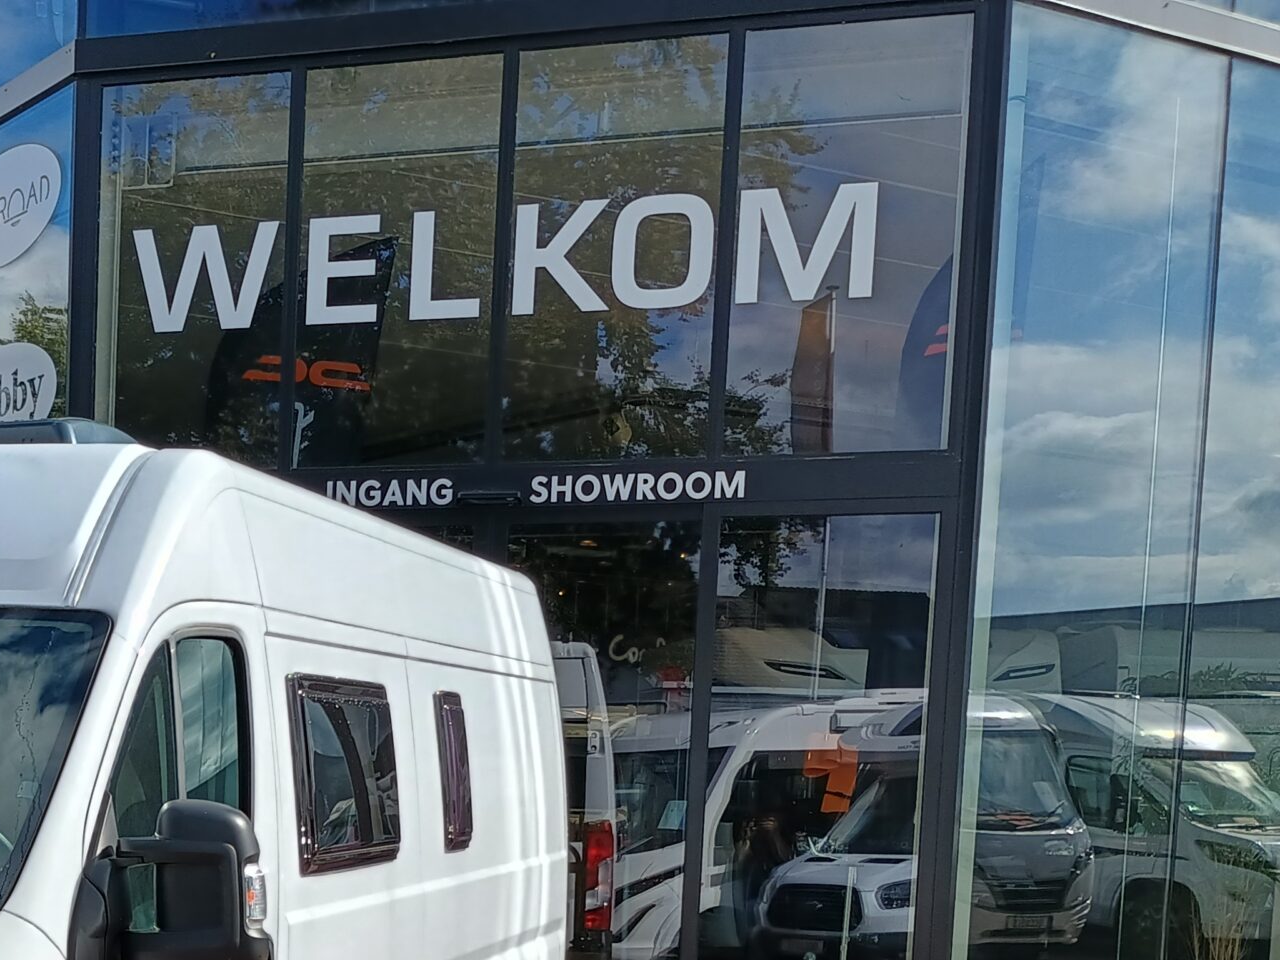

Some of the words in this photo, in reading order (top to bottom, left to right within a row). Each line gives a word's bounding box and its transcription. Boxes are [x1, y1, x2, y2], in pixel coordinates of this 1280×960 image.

[133, 181, 880, 333] WELKOM
[326, 478, 453, 507] INGANG
[530, 470, 746, 504] SHOWROOM
